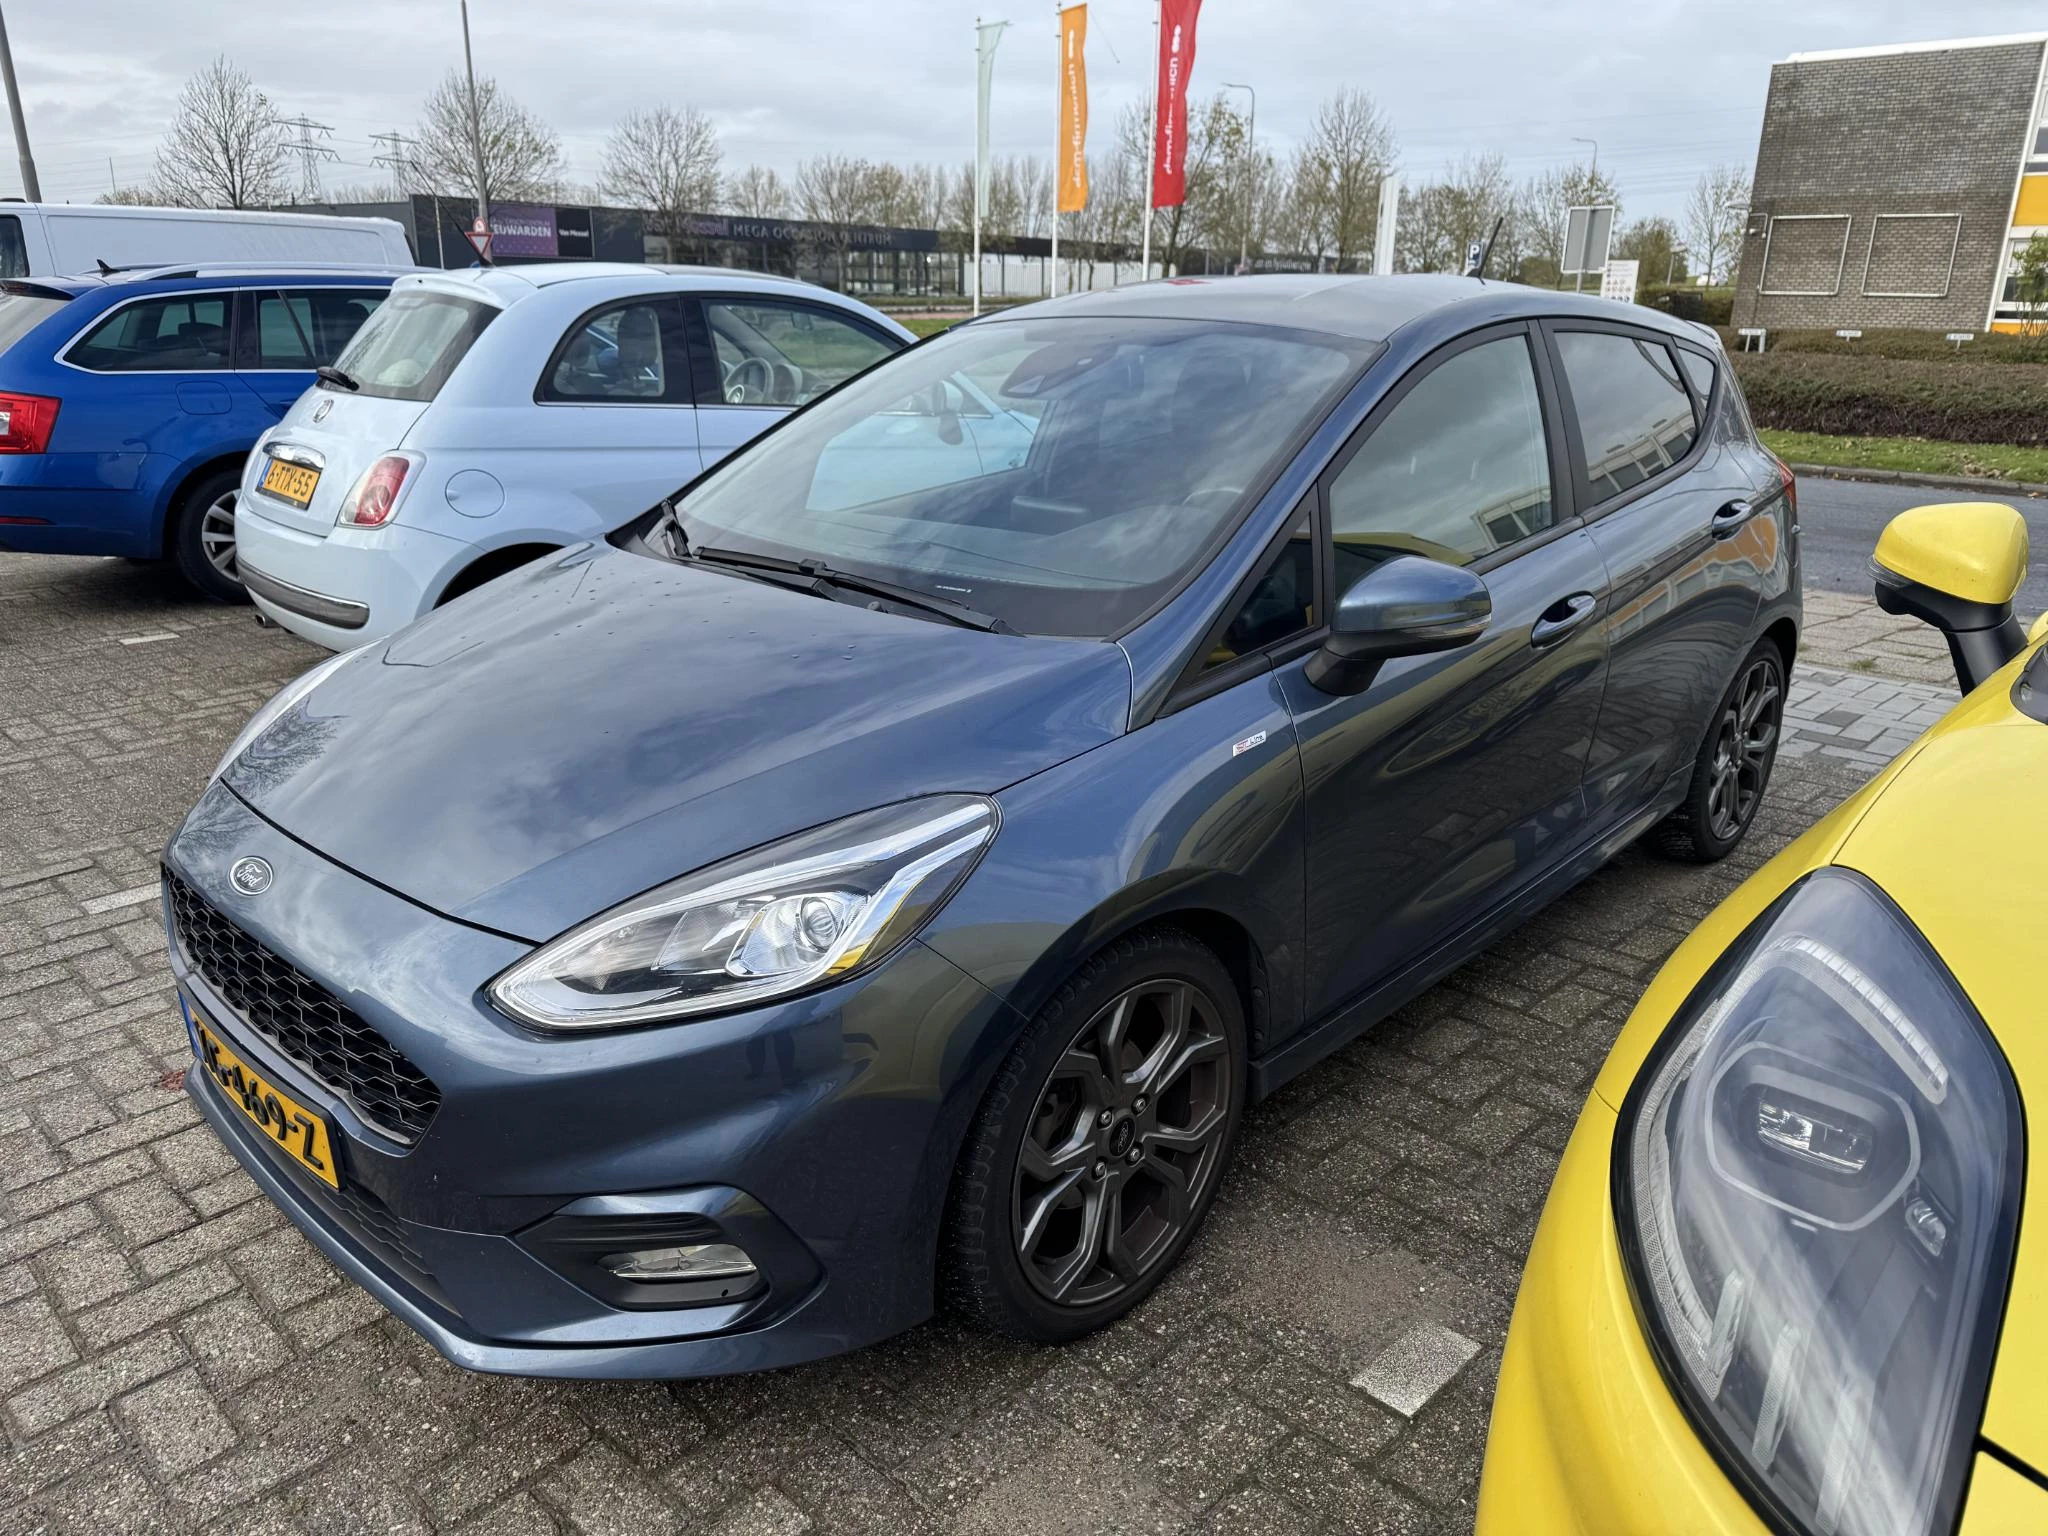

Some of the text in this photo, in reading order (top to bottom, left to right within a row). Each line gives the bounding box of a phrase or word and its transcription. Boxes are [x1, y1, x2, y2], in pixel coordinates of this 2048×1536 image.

[733, 224, 769, 238] MEGA
[1470, 245, 1480, 259] P
[268, 463, 313, 497] 6-TTX-55
